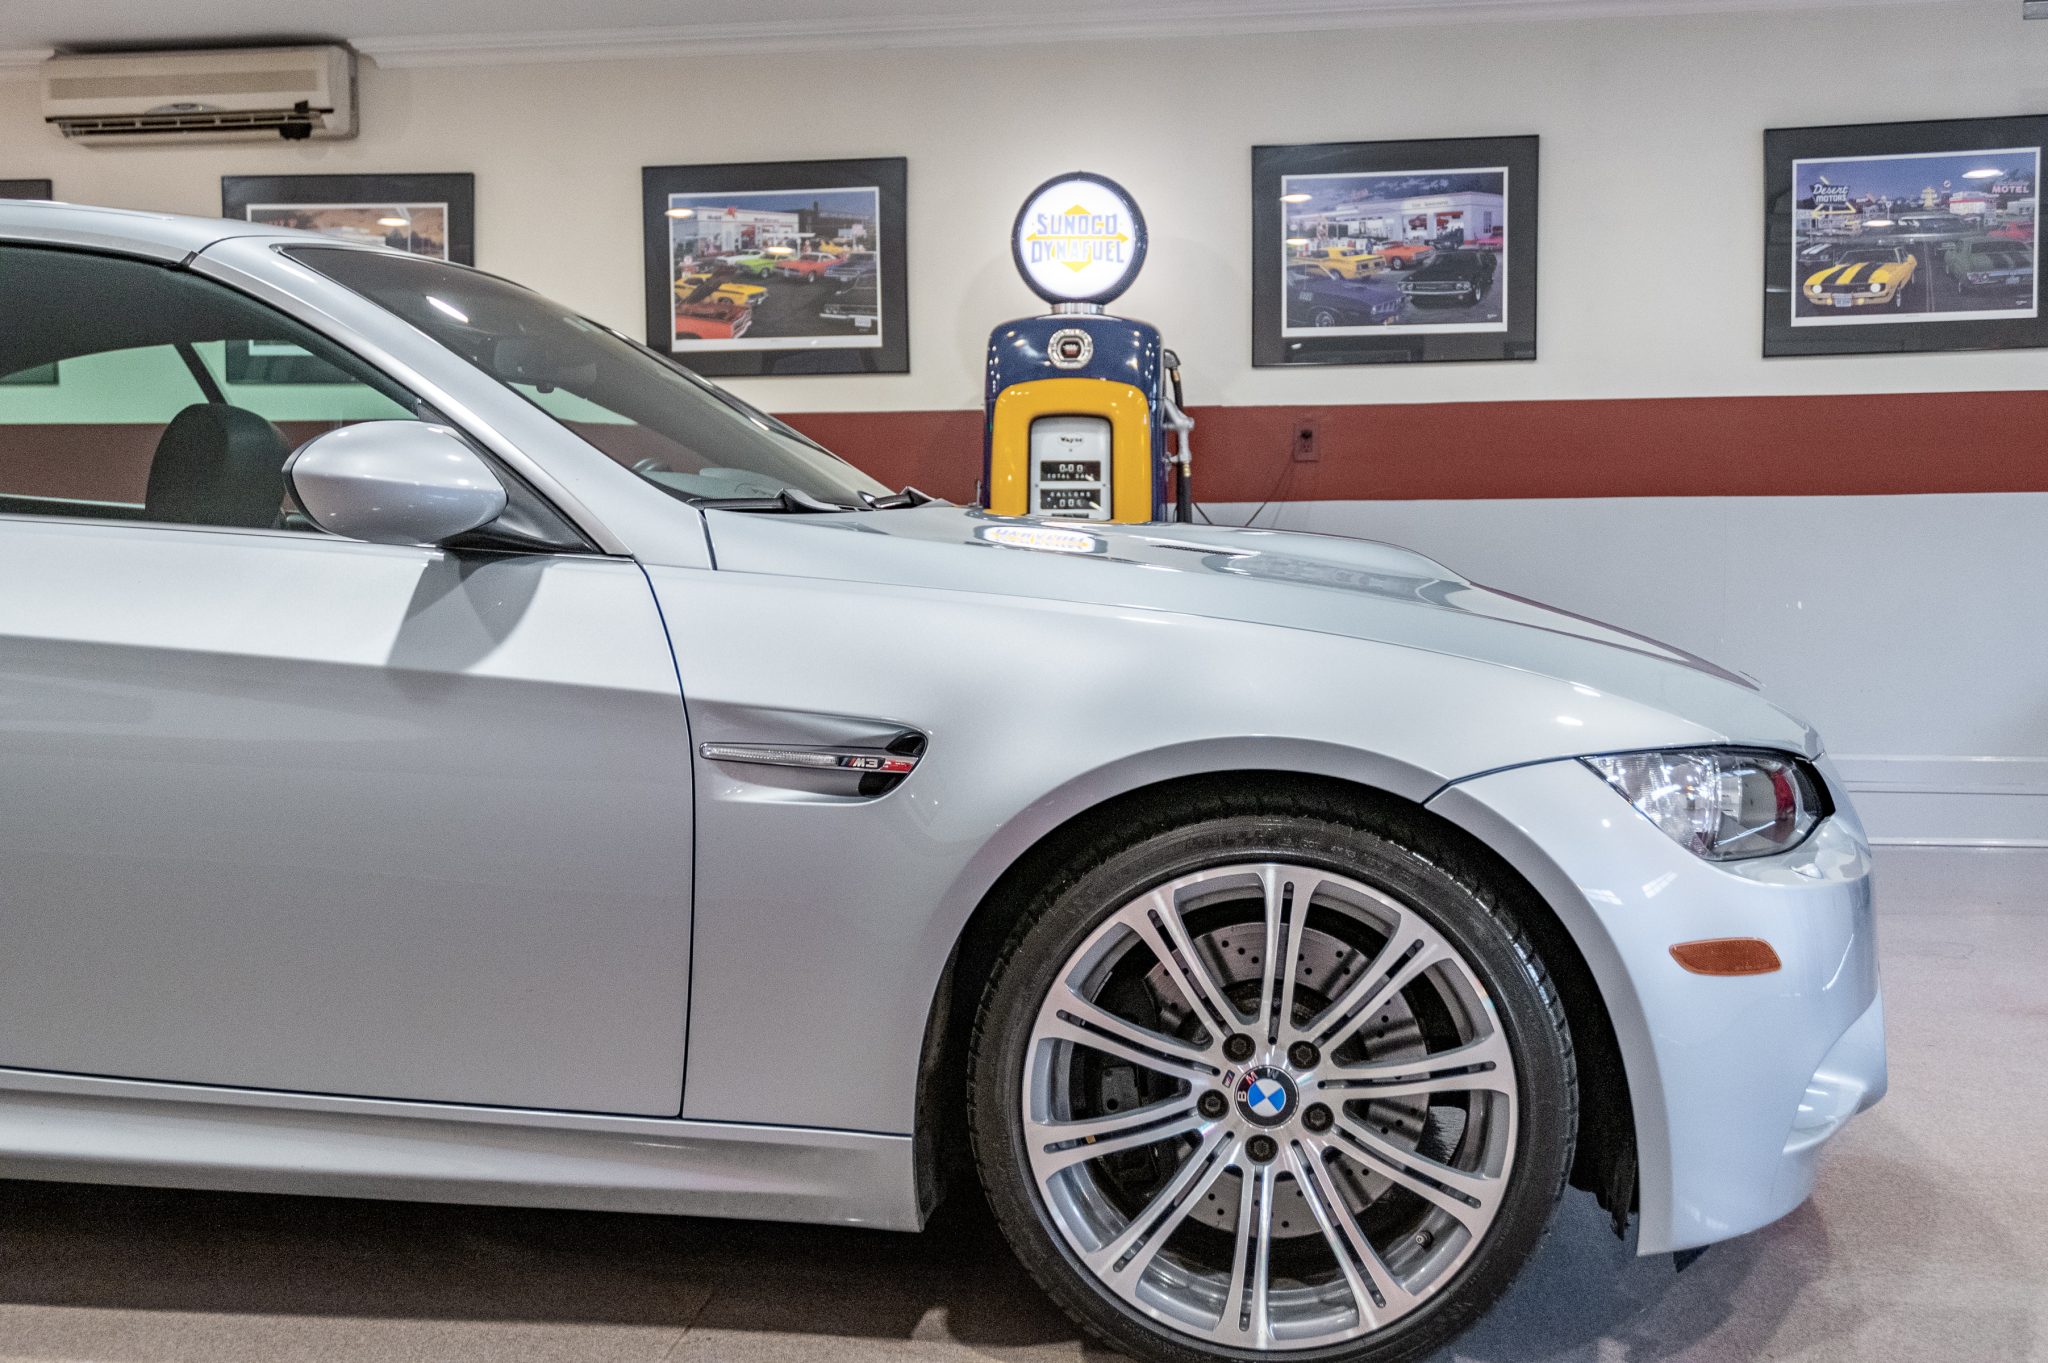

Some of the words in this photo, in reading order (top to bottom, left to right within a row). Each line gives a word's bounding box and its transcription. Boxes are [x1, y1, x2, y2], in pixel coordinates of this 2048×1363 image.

[1812, 183, 1849, 195] Desert
[1991, 185, 2029, 194] MOTEL
[1816, 194, 1847, 203] MOTORS
[1036, 213, 1118, 235] SUNOCO
[1030, 240, 1125, 264] DYNAFUEL
[1237, 1068, 1280, 1102] BMW
